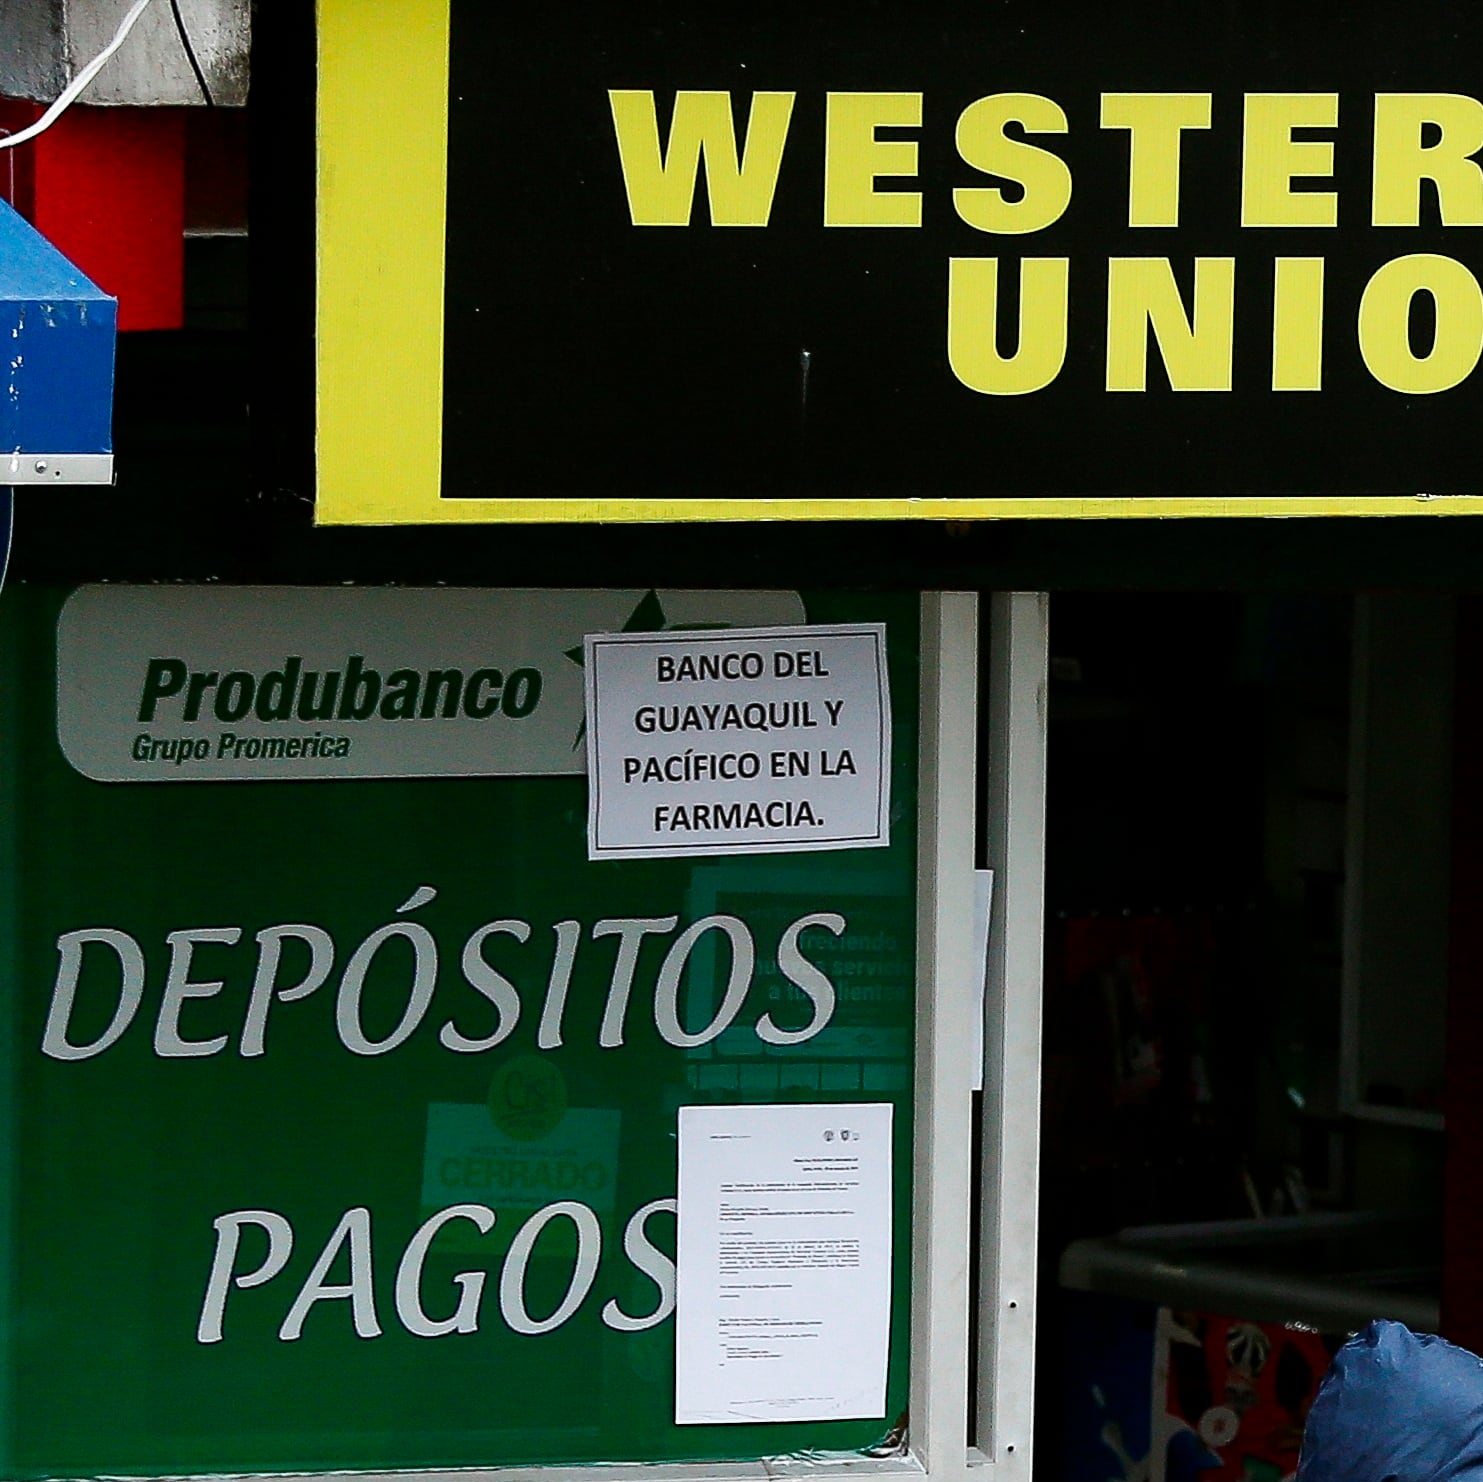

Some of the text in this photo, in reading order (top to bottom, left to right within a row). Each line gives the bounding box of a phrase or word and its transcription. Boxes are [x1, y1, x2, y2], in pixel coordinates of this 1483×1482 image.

[656, 650, 831, 682] BANCO DEL
[138, 655, 542, 724] Produbanco
[634, 699, 845, 734] GUAYAQUIL Y
[131, 730, 350, 766] Grupo Promerica
[624, 746, 858, 784] PACÍFICO EN LA
[654, 800, 825, 833] FARMACIA.
[39, 886, 848, 1060] DEPÓSITOS
[197, 1200, 677, 1343] PAGOS
